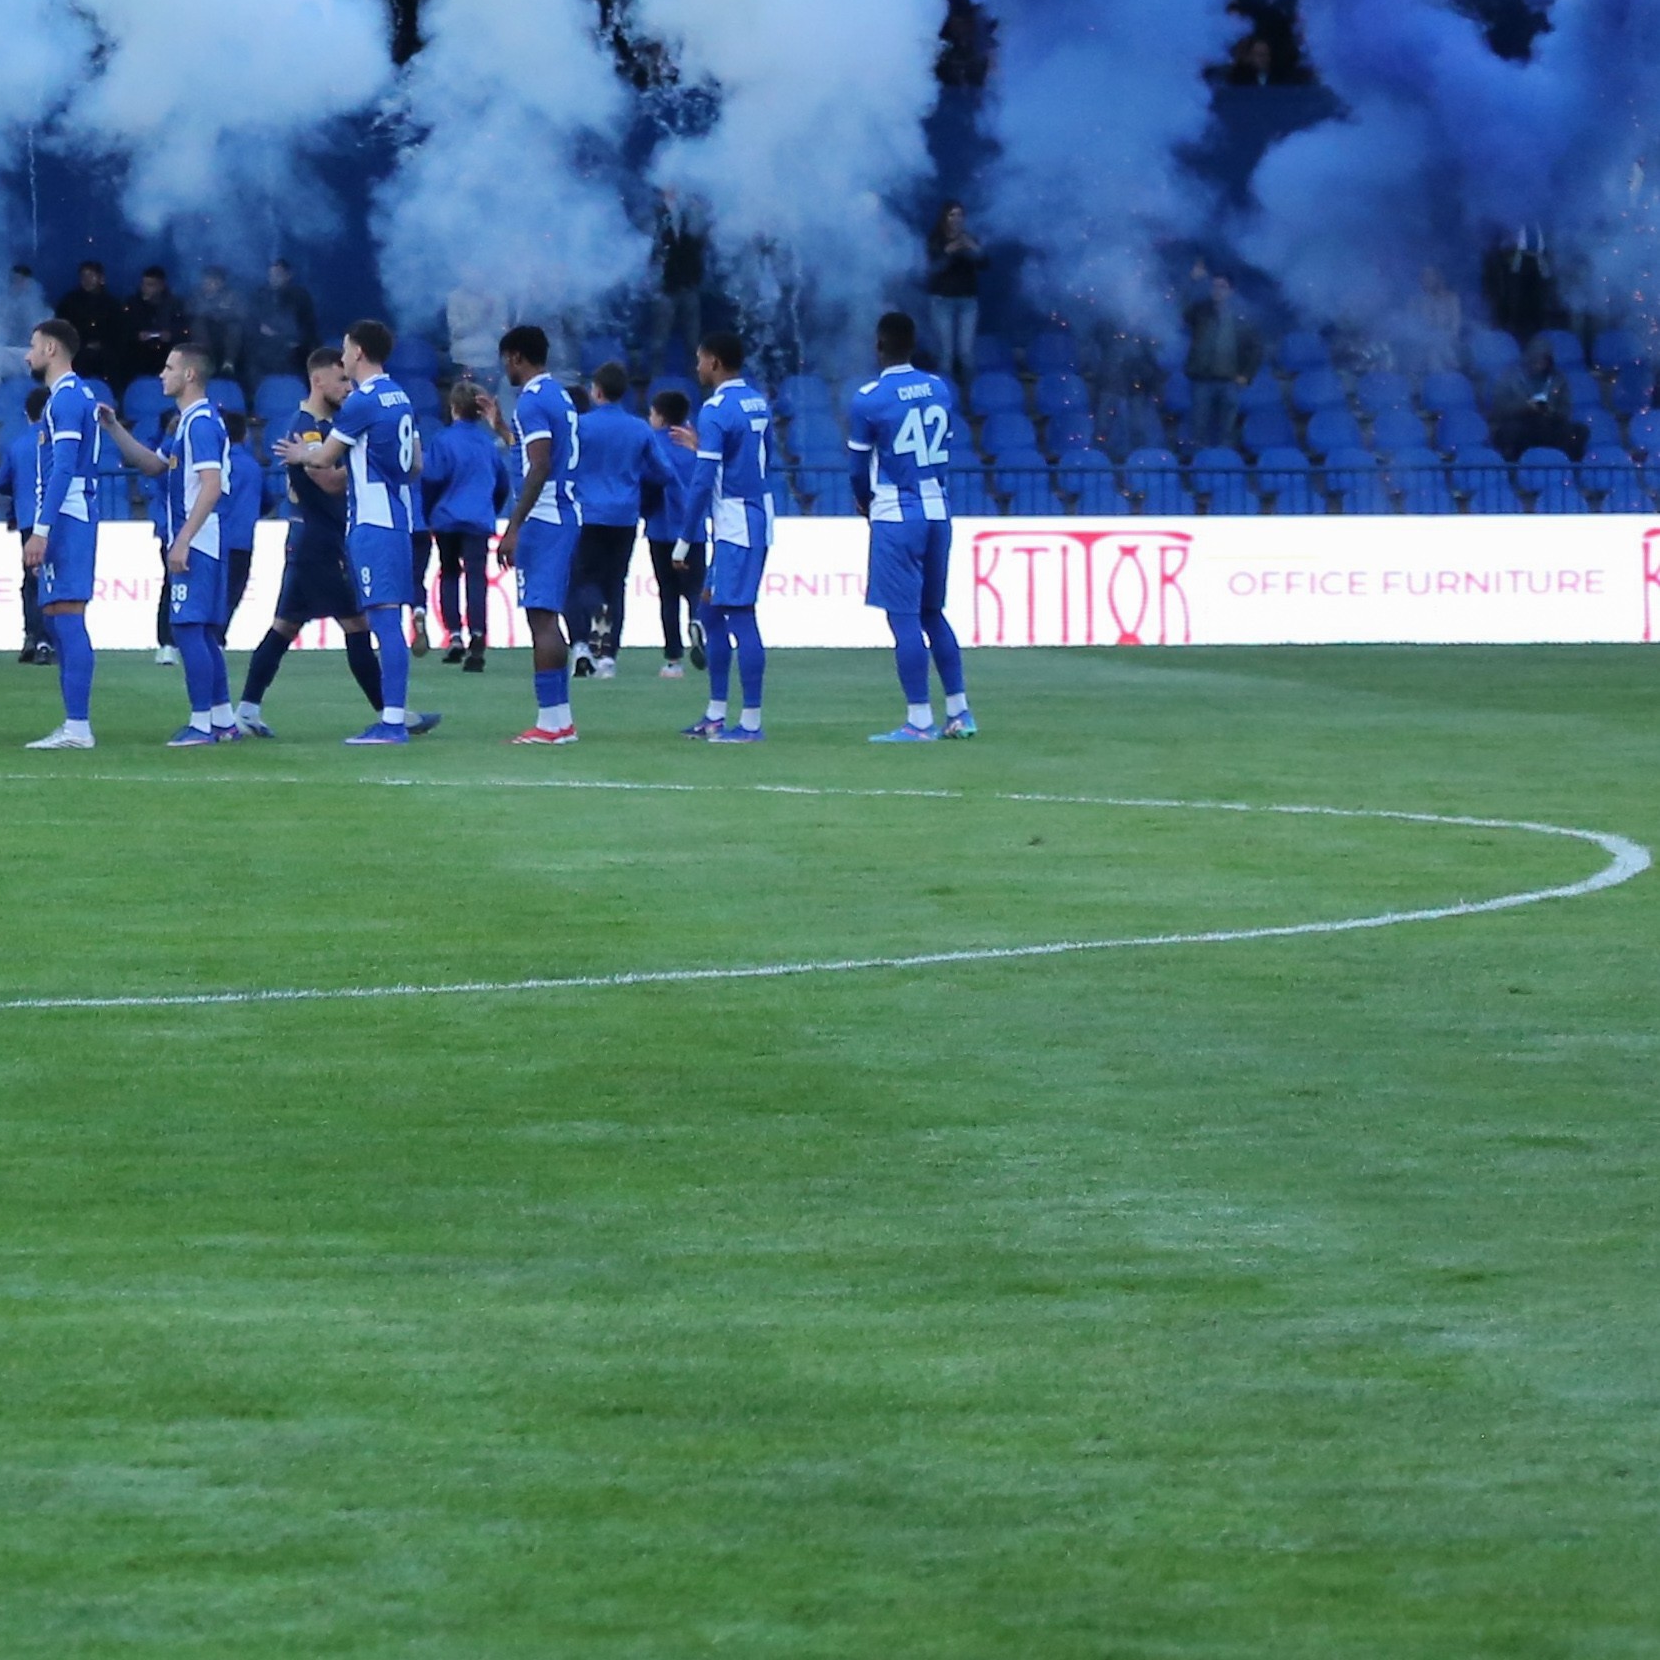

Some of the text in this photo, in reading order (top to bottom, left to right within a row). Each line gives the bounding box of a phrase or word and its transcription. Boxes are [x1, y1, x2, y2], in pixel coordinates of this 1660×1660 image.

[399, 414, 413, 473] 8
[750, 418, 769, 479] 7
[893, 404, 949, 467] 42
[361, 566, 371, 585] 8
[1227, 569, 1605, 596] OFFICE FURNITURE
